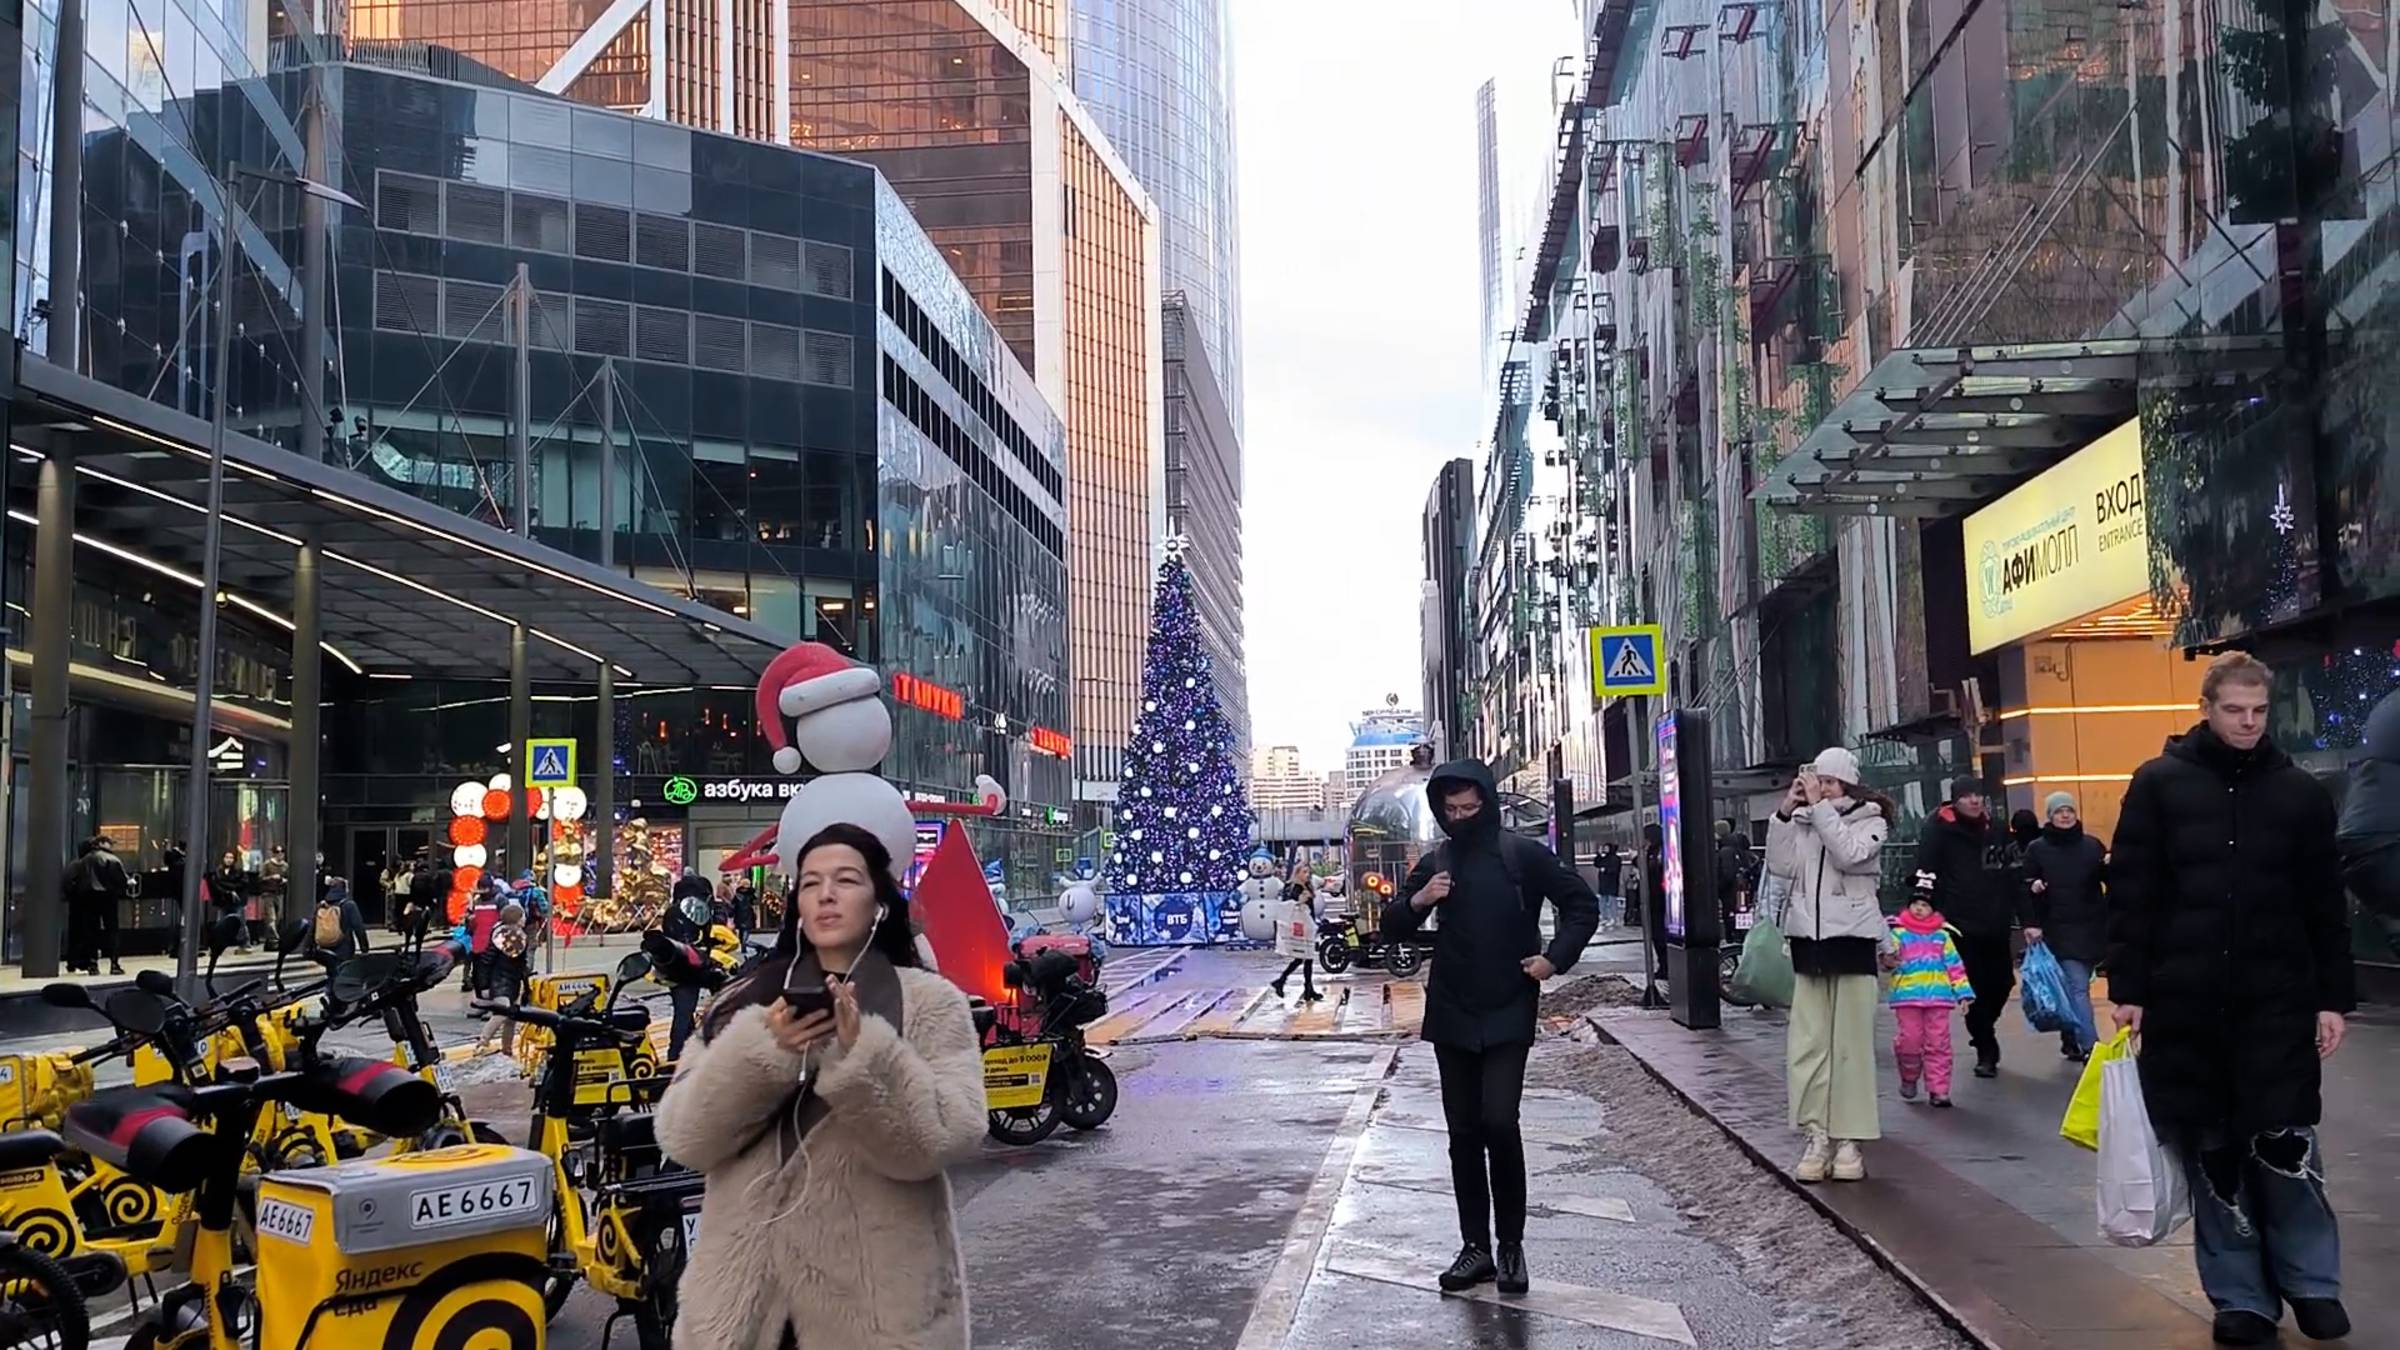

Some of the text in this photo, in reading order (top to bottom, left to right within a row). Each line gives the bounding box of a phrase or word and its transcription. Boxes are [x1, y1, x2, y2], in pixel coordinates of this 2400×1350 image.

[2096, 473, 2144, 524] ВХОД
[2098, 518, 2144, 552] ENTRANCE
[2002, 525, 2079, 596] АФИМОЛЛ
[704, 779, 773, 802] азбука
[1167, 914, 1188, 925] ВТБ
[335, 1262, 424, 1292] Яндекс
